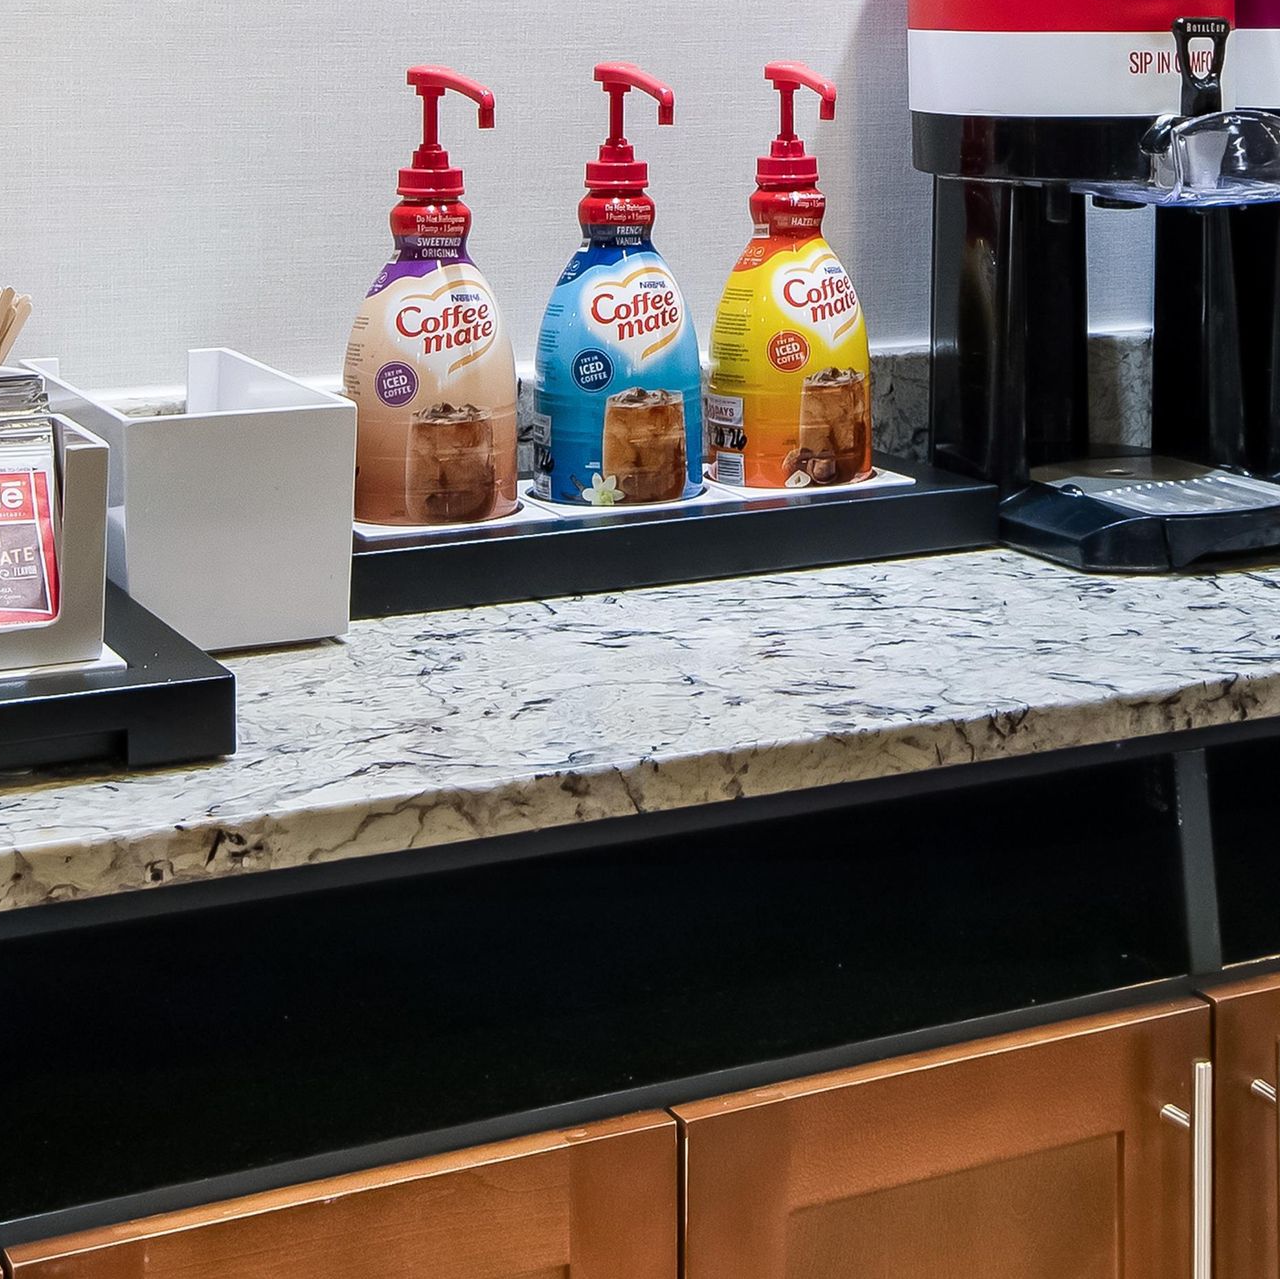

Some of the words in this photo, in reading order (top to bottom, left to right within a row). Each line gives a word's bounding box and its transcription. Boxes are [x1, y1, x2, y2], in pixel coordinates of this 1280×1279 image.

[1129, 51, 1153, 74] SIP
[1157, 51, 1171, 74] IN
[616, 225, 643, 235] FRENCH
[417, 237, 461, 247] SWEETENED
[615, 236, 642, 246] VANILLA
[421, 248, 459, 258] ORIGINAL
[783, 274, 851, 308] Coffee
[591, 290, 674, 324] Coffee
[810, 289, 857, 323] mate
[395, 304, 488, 338] Coffee
[617, 306, 679, 341] mate
[424, 319, 493, 355] mate
[775, 342, 801, 357] ICED
[578, 361, 604, 376] ICED
[382, 374, 408, 390] ICED
[580, 371, 608, 384] COFFEE
[383, 385, 412, 399] COFFEE
